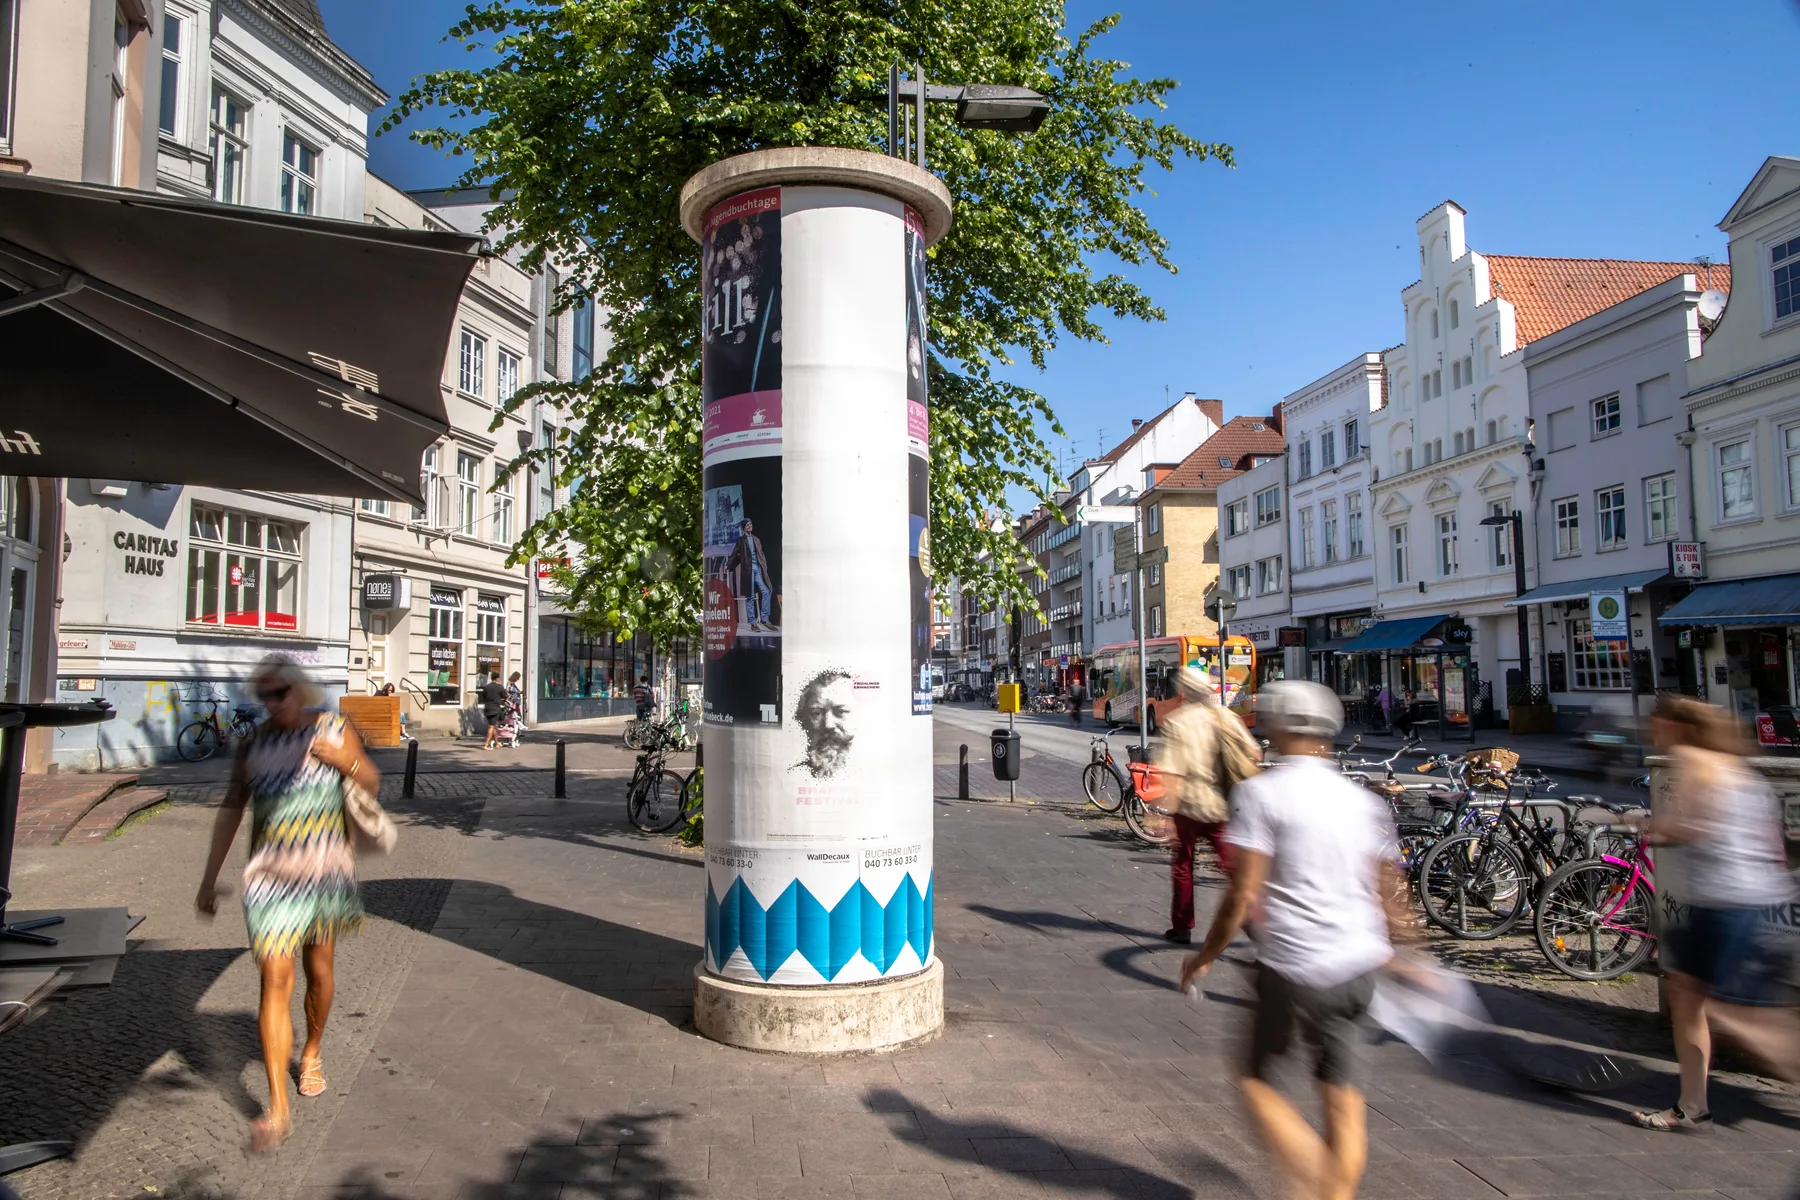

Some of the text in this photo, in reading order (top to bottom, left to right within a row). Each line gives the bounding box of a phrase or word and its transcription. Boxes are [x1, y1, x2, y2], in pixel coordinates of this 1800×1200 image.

[710, 196, 777, 228] Jugendbuchtage
[113, 531, 178, 557] CARITAS
[1675, 544, 1698, 552] KIOSK
[1676, 553, 1698, 562] & FUN
[124, 555, 164, 577] HAUS
[708, 591, 721, 605] Wir
[1453, 630, 1469, 639] sky
[1634, 629, 1643, 638] 53
[806, 853, 850, 861] WallDecaux
[865, 847, 902, 859] BUCHBAR
[719, 856, 726, 866] 73
[726, 858, 734, 867] 60
[736, 859, 753, 869] 33-0
[864, 854, 918, 868] 040 73 60 33-0
